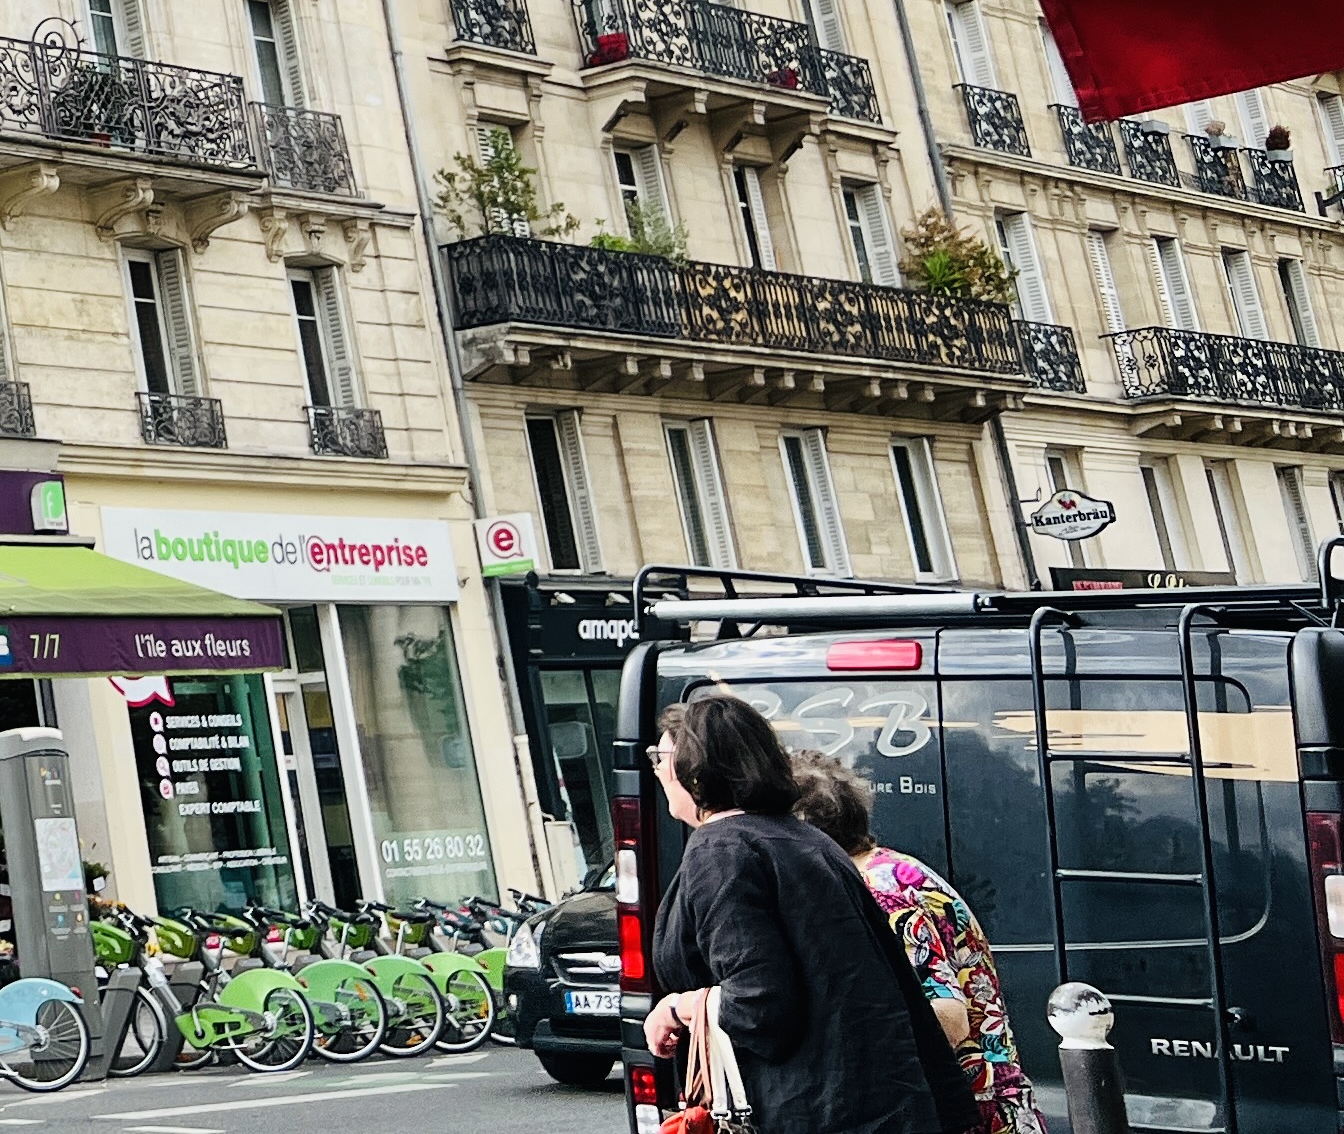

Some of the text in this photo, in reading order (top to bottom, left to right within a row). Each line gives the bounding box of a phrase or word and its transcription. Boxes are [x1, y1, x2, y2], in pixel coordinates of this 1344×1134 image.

[1033, 509, 1108, 527] Kanterbräu
[30, 633, 60, 659] 7/7
[135, 633, 251, 657] l'île aux fleurs
[179, 800, 261, 816] EXPERT COMPTABLE
[382, 834, 485, 863] 01 55 26 80 32
